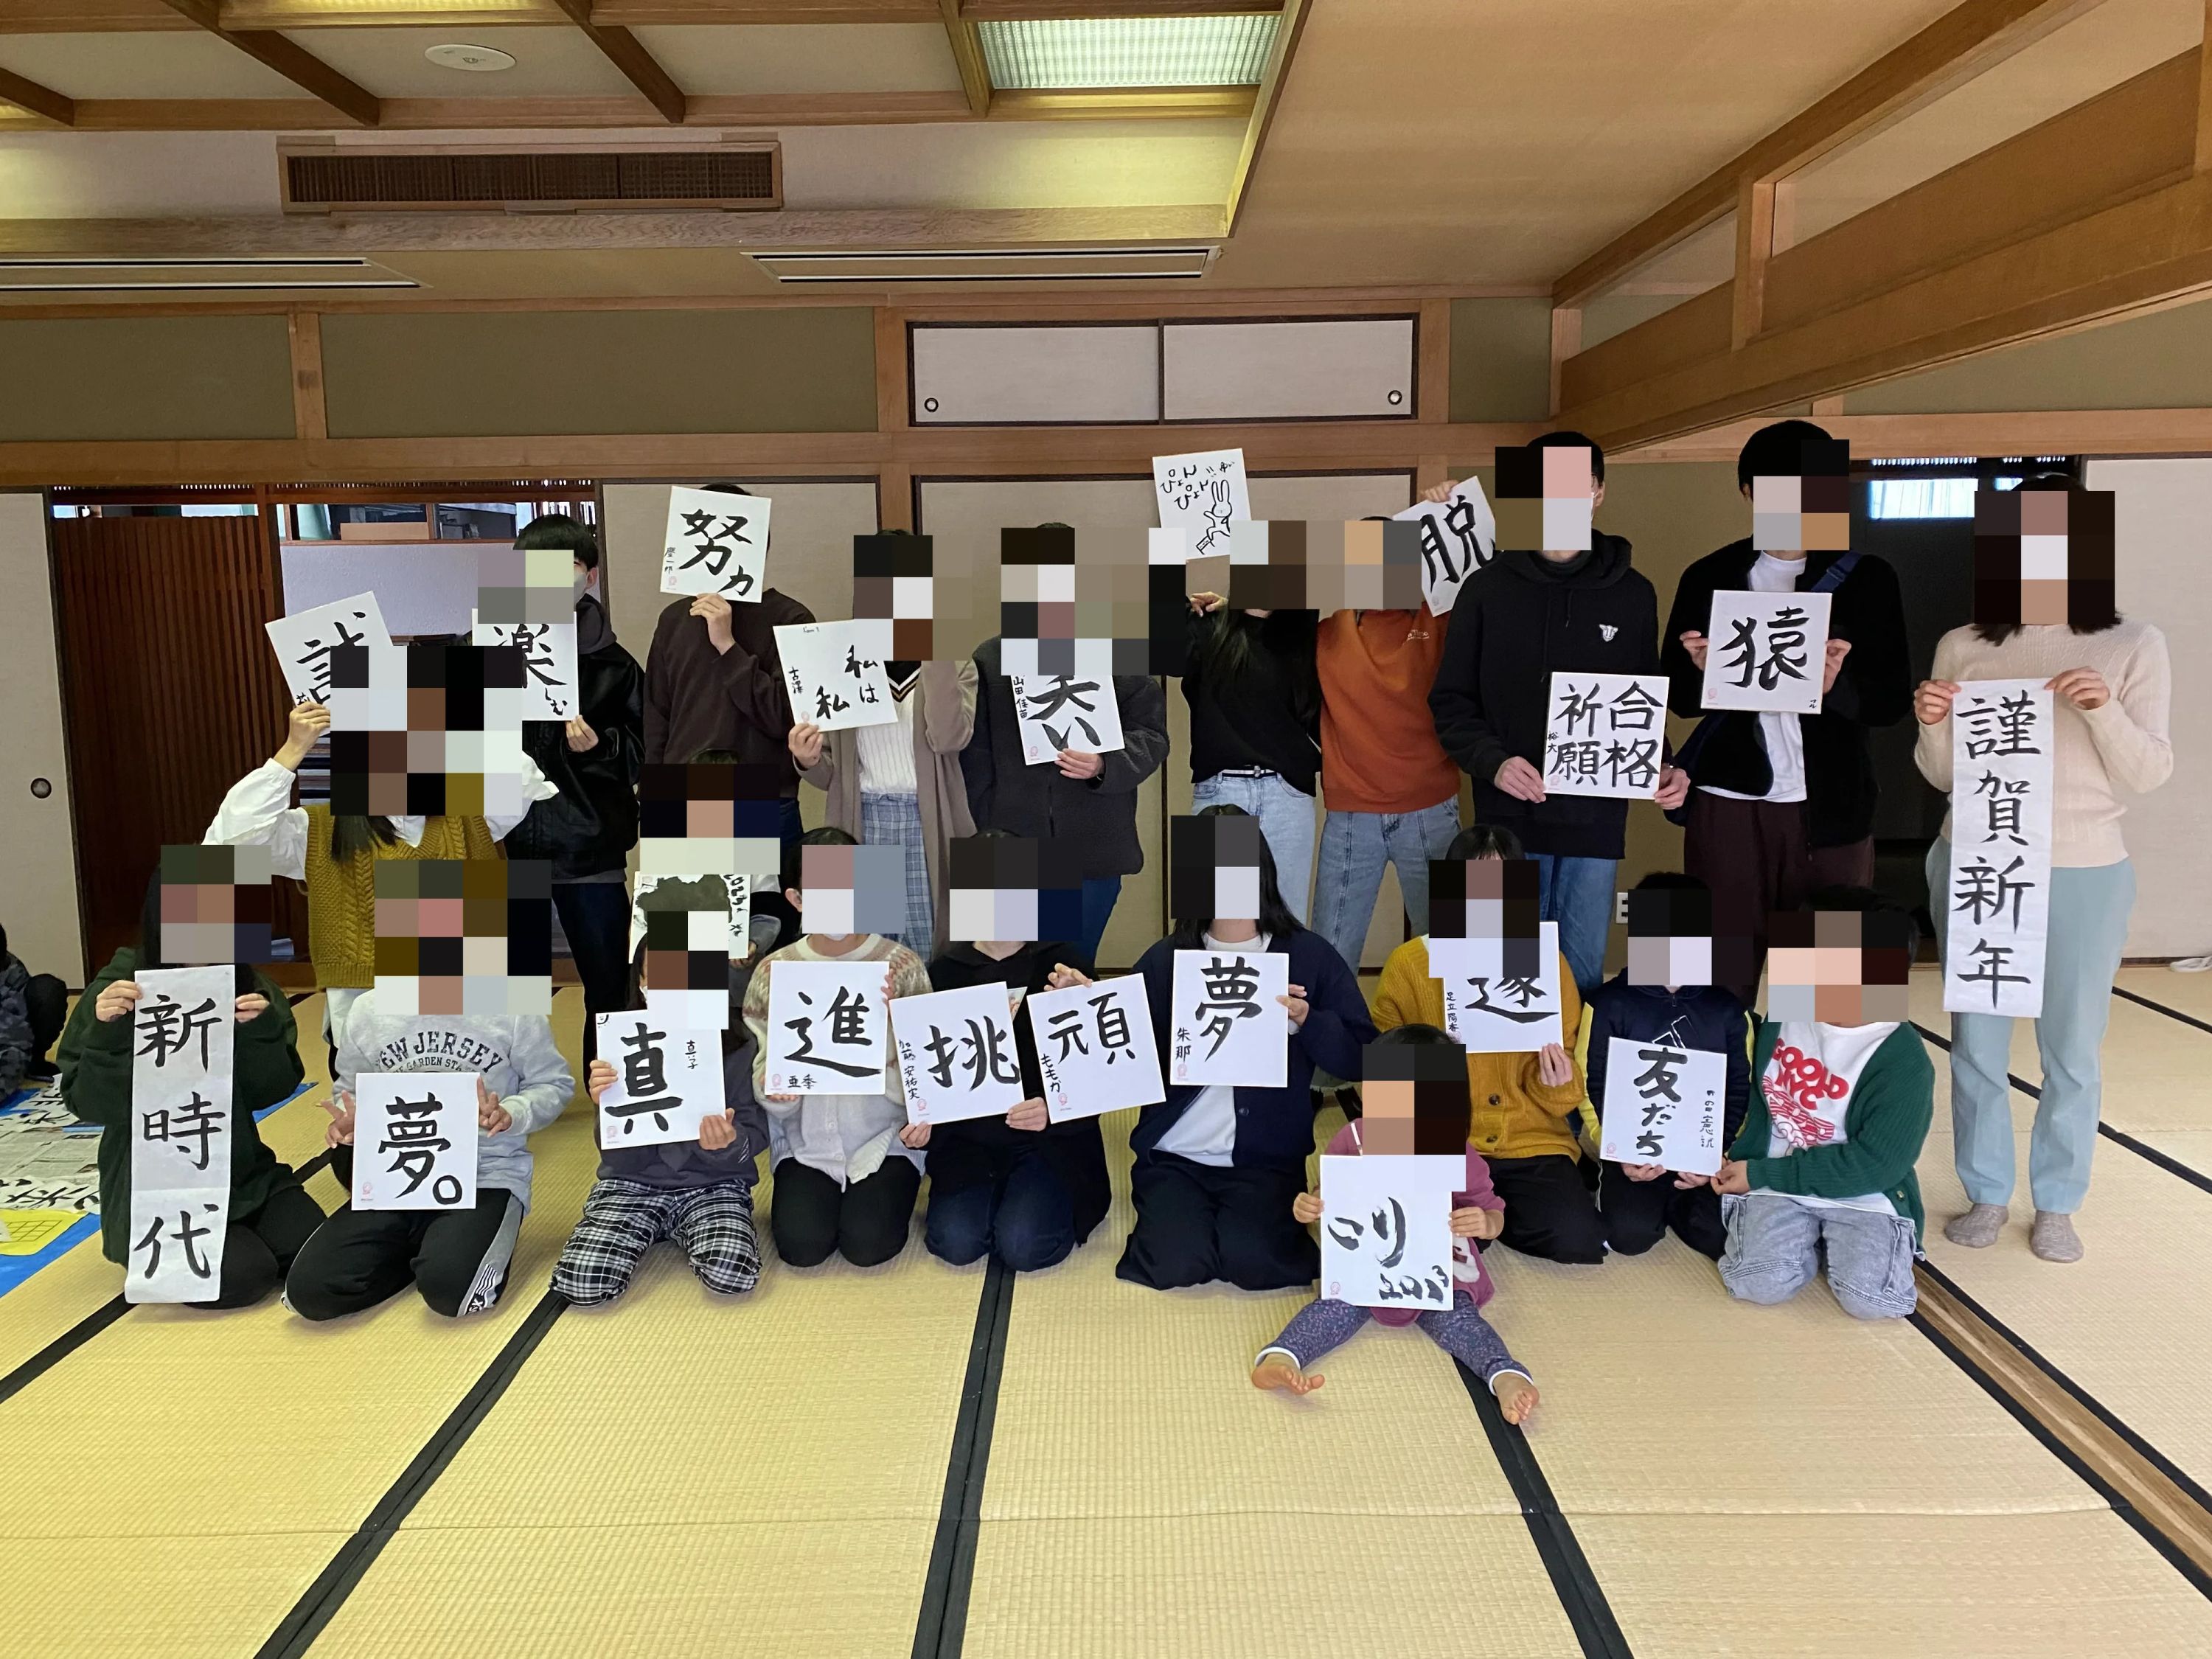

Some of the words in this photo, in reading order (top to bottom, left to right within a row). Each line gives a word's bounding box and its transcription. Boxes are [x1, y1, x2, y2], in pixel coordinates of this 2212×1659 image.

[678, 509, 754, 597] 努力
[1421, 495, 1495, 593] 脱
[1717, 606, 1810, 691] 猿
[816, 686, 850, 720] 私
[1548, 683, 1604, 786] 祈願
[1600, 681, 1663, 788] 合格
[1952, 689, 2041, 1009] 謹賀新年
[377, 1037, 409, 1069] EW
[413, 1032, 503, 1073] JERSEY
[784, 986, 882, 1077] 進
[923, 1015, 1020, 1092] 挑
[1048, 992, 1135, 1065] 頑
[1195, 956, 1262, 1062] 夢
[605, 1022, 684, 1134] 真
[1633, 1047, 1688, 1157] 友だち
[134, 995, 226, 1279] 新時代
